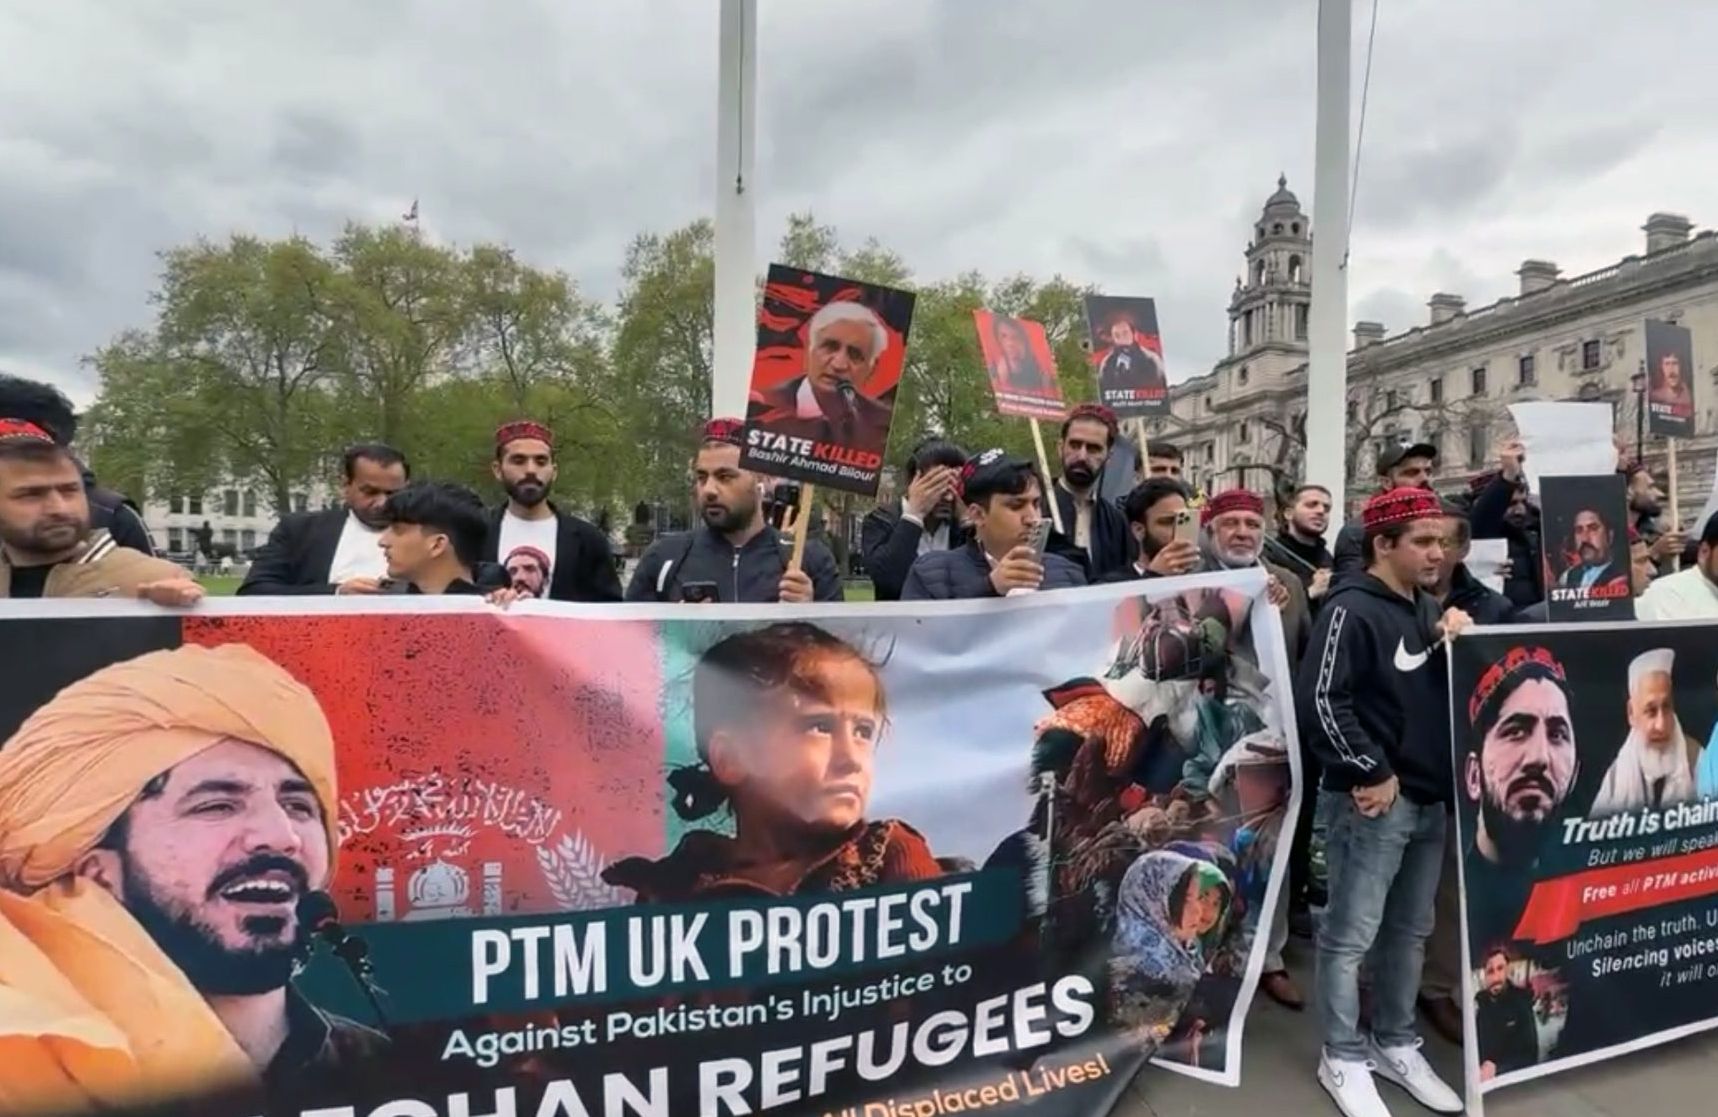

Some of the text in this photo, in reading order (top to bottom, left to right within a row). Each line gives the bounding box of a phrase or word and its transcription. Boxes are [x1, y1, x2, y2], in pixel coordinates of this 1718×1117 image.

[1105, 390, 1135, 400] STATE
[748, 430, 880, 468] STATE KILLED
[748, 448, 876, 481] Bashir Ahmad Bilour
[1552, 585, 1628, 601] STATE KILLED
[1562, 811, 1636, 844] Truth
[1638, 808, 1660, 834] is
[1588, 848, 1618, 866] But
[1623, 847, 1645, 862] we
[1651, 838, 1677, 857] will
[1583, 884, 1617, 904] Free
[1622, 878, 1640, 895] all
[1643, 871, 1676, 891] PTM
[472, 882, 972, 1004] PTM UK PROTEST
[1567, 930, 1628, 959] Unchain
[1633, 924, 1656, 942] the
[1592, 948, 1668, 978] Silencing
[1660, 970, 1672, 988] it
[1677, 964, 1703, 984] will
[441, 964, 972, 1067] Against Pakistan's Injustice to
[698, 974, 1094, 1117] REFUGEES
[1022, 1053, 1111, 1097] Lives!
